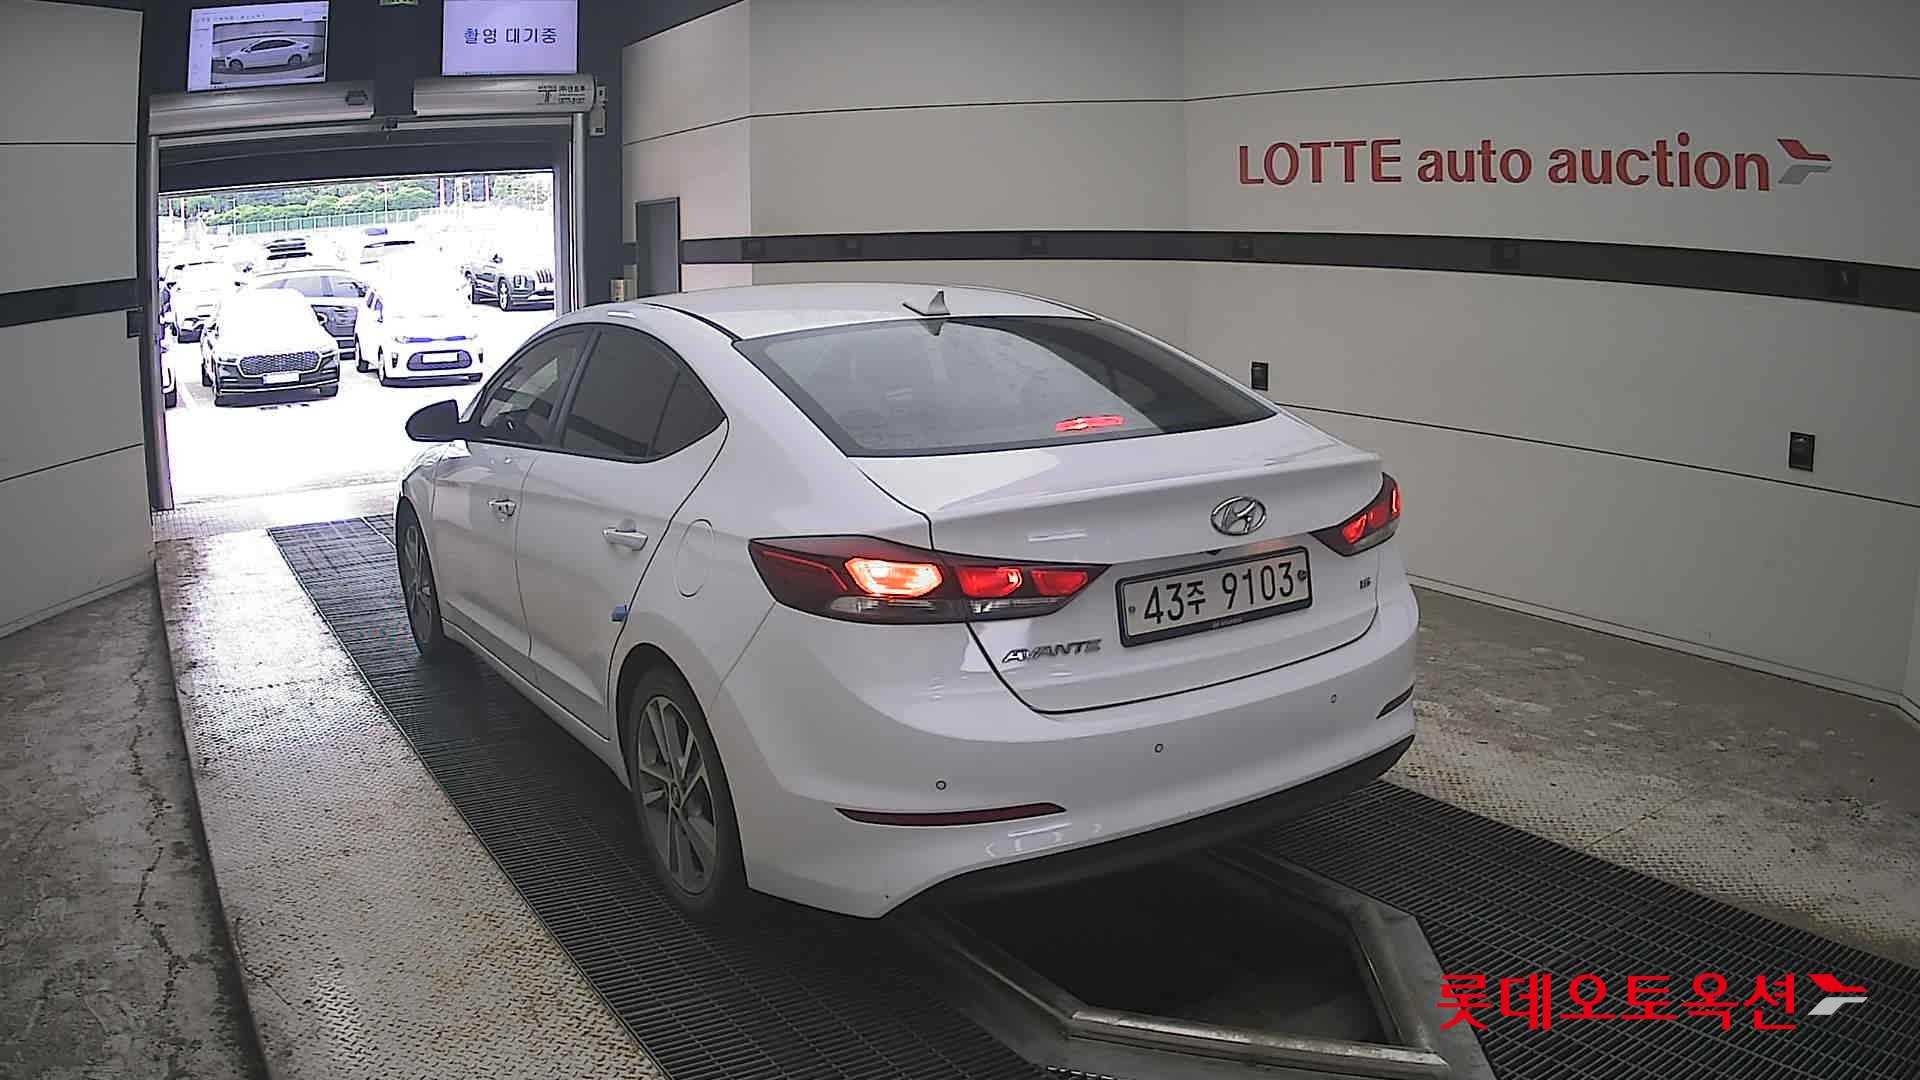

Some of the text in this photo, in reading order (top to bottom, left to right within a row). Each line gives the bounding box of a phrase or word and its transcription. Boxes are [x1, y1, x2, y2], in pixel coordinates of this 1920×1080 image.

[464, 28, 557, 45] 촬영 대기중
[1239, 131, 1770, 191] LOTTE auto auction
[1143, 561, 1294, 624] 43주 9103
[1002, 639, 1102, 663] AVANTE
